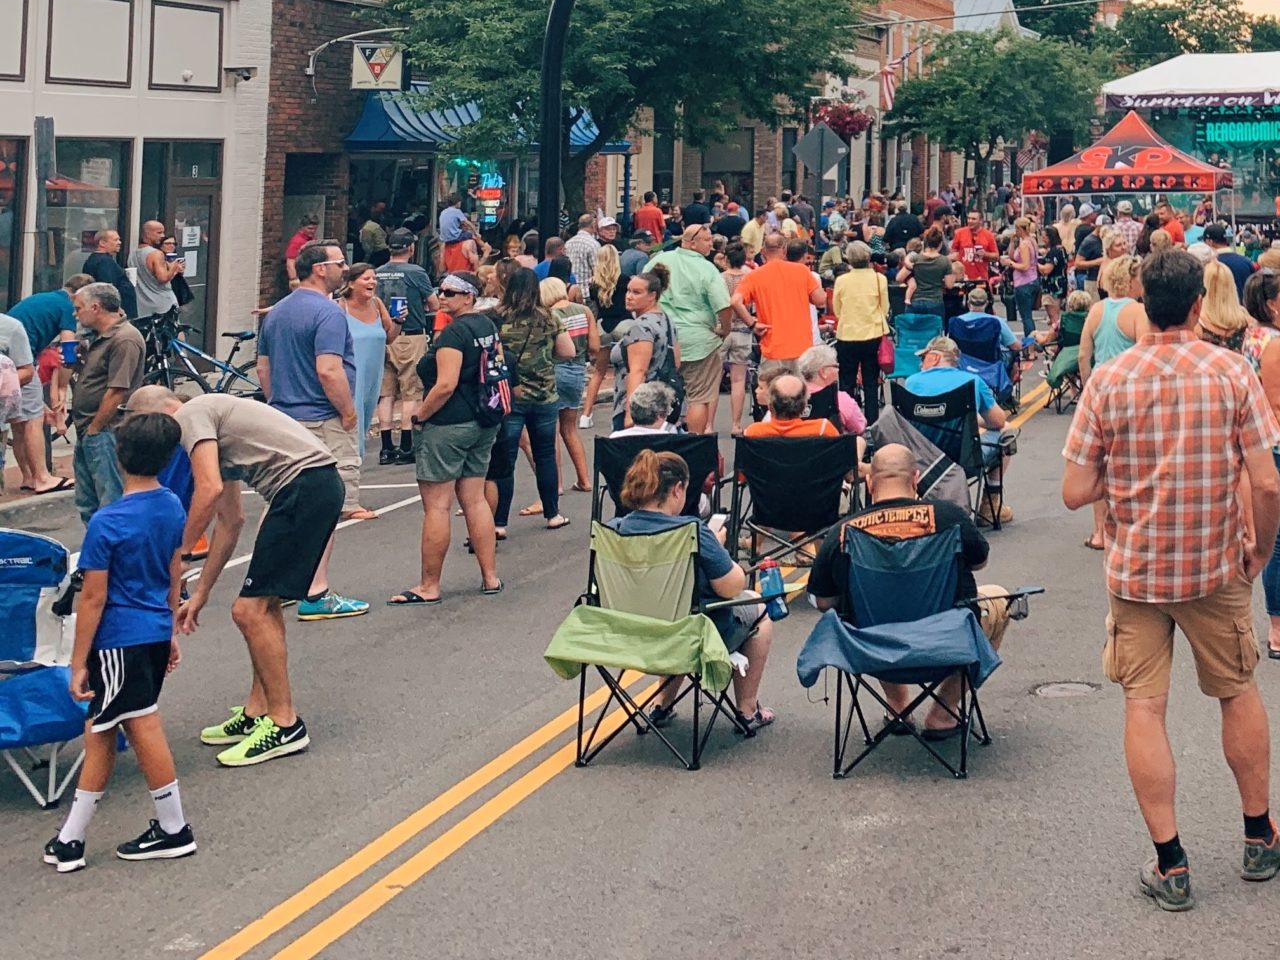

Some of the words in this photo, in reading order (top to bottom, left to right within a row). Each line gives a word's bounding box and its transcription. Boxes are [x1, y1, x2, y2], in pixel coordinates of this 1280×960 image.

[1120, 94, 1219, 107] Summer
[1223, 96, 1259, 106] on
[1078, 146, 1172, 169] SKP
[883, 506, 929, 524] TEMPLE
